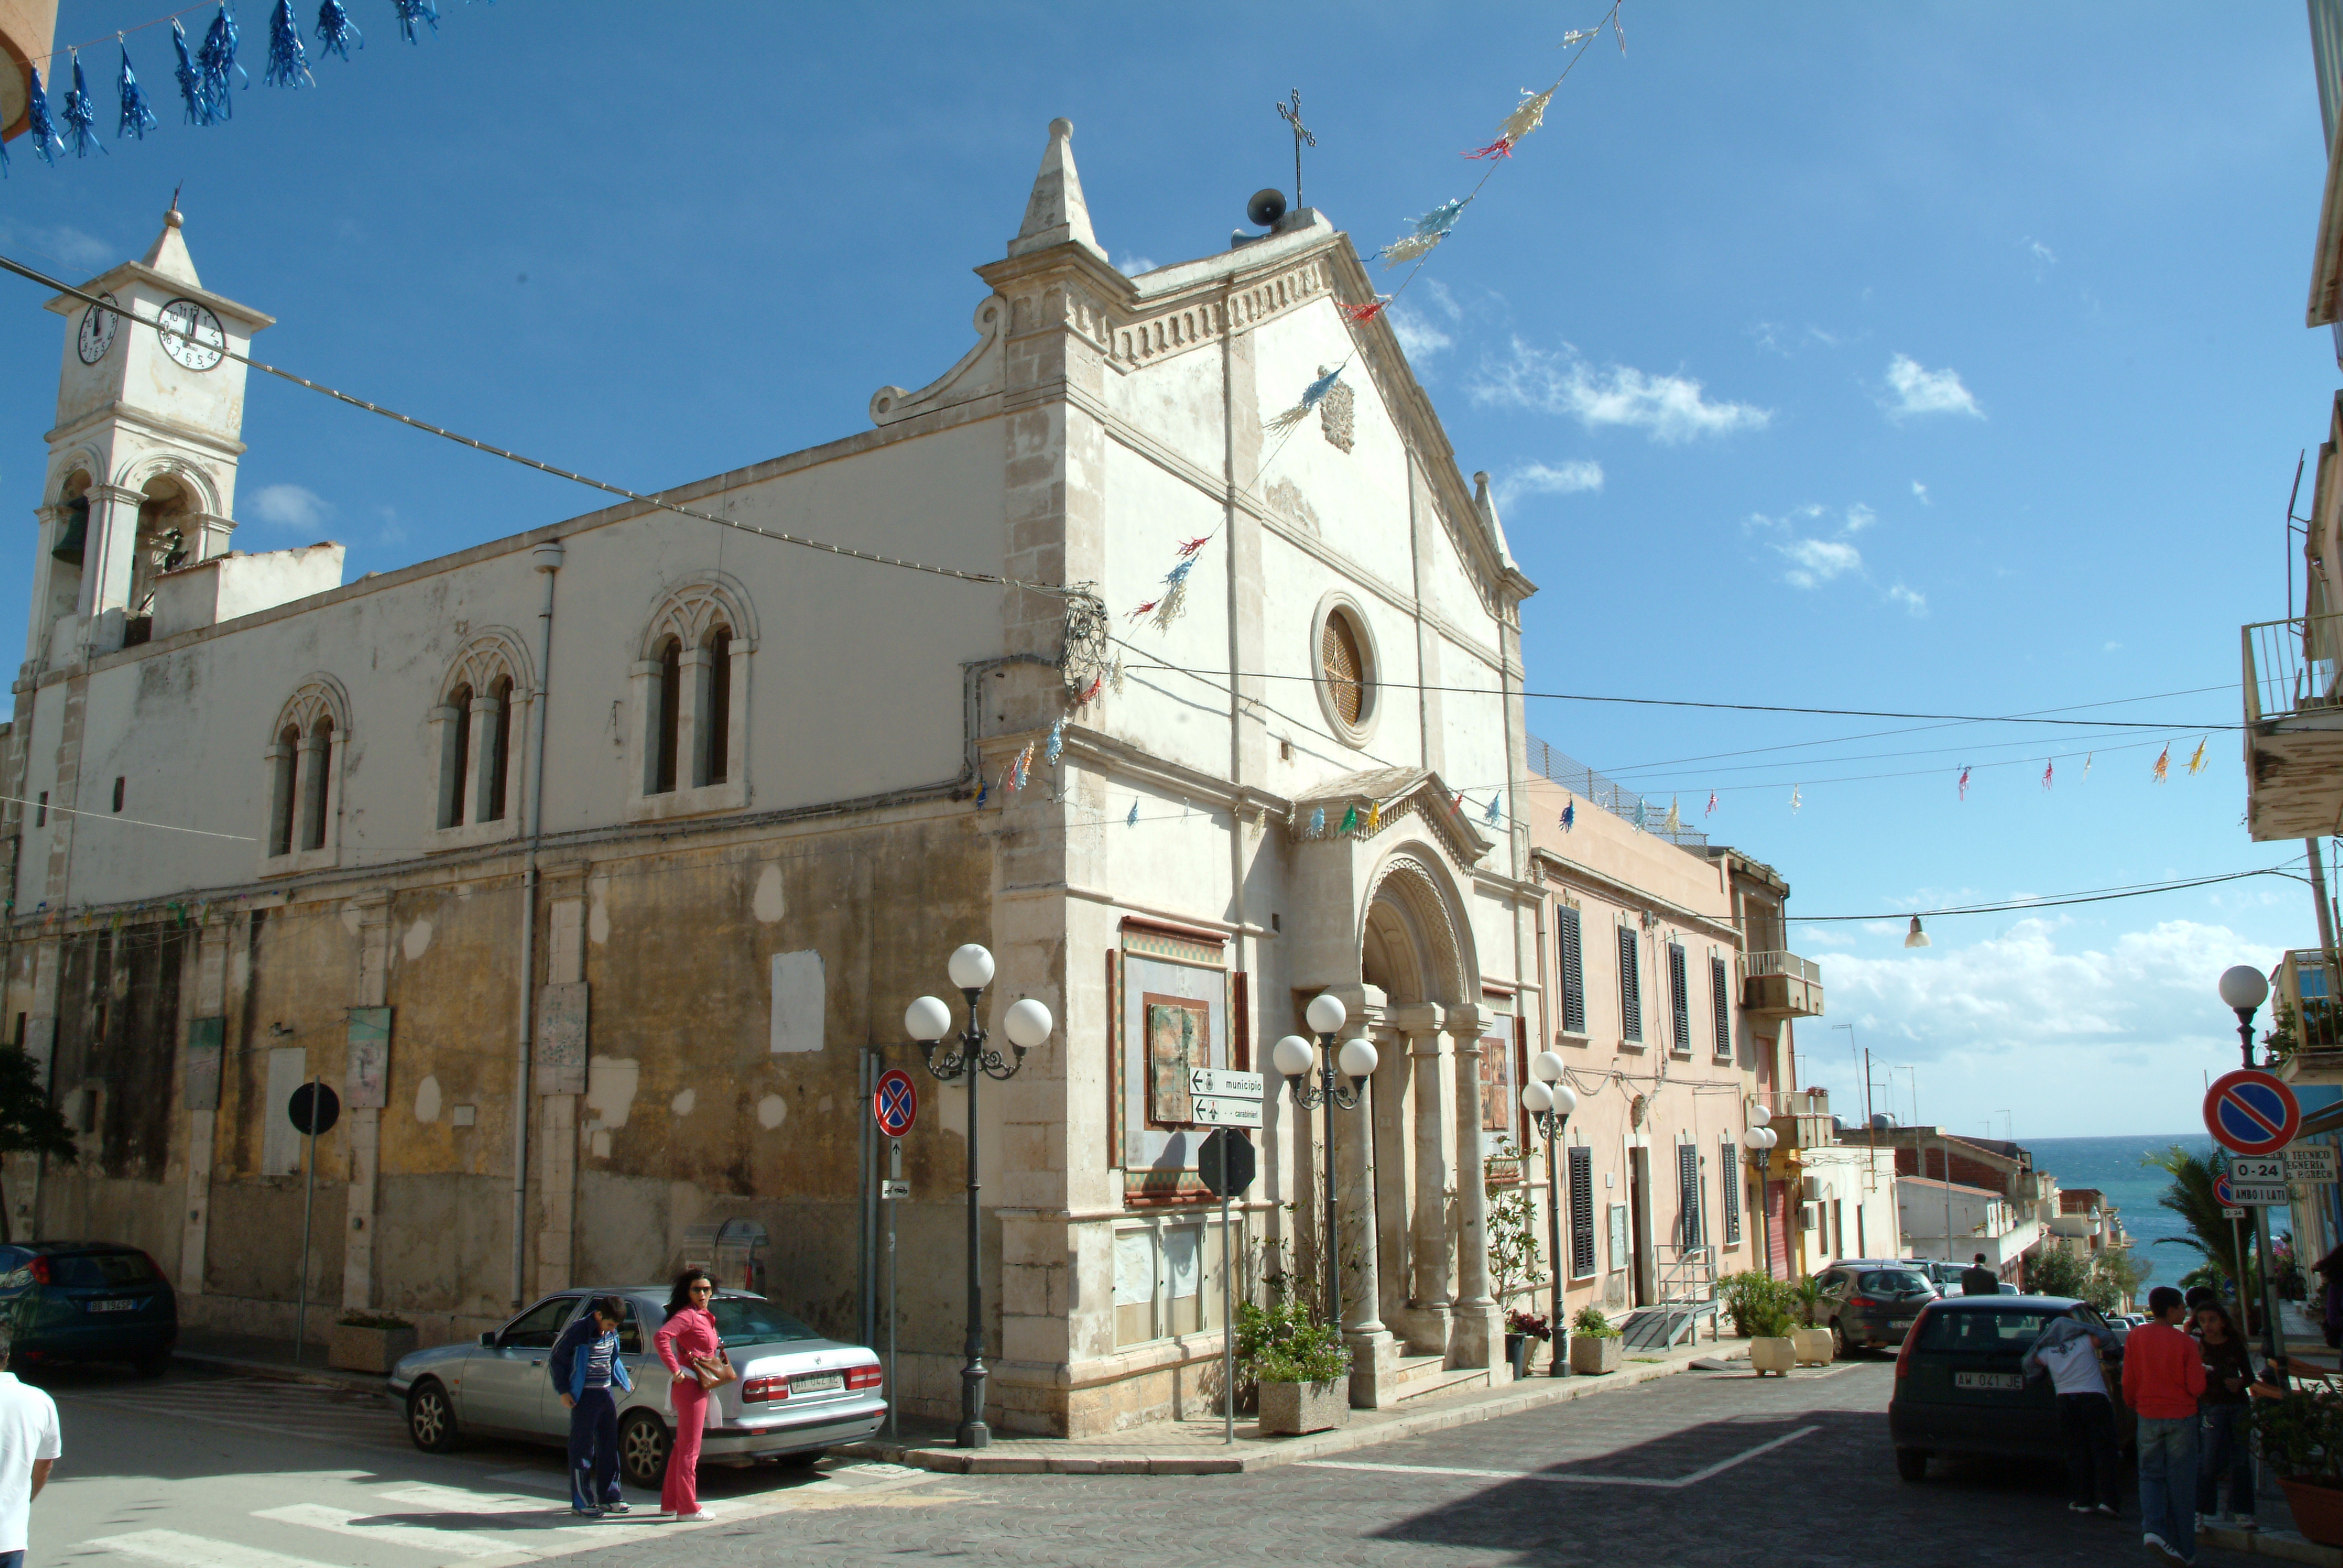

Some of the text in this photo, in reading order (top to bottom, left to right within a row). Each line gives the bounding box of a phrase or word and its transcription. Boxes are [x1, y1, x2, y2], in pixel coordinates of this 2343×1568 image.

[170, 311, 178, 322] 10
[210, 327, 216, 337] 2
[186, 353, 192, 362] 6
[198, 355, 203, 364] 5
[1226, 1079, 1262, 1092] municipio
[1235, 1110, 1258, 1118] carabinieri
[2291, 1151, 2330, 1159] TECNICO
[2235, 1189, 2285, 1200] AMBO I LATI
[810, 1374, 826, 1386] 042
[1958, 1373, 2021, 1387] AW 041 JE
